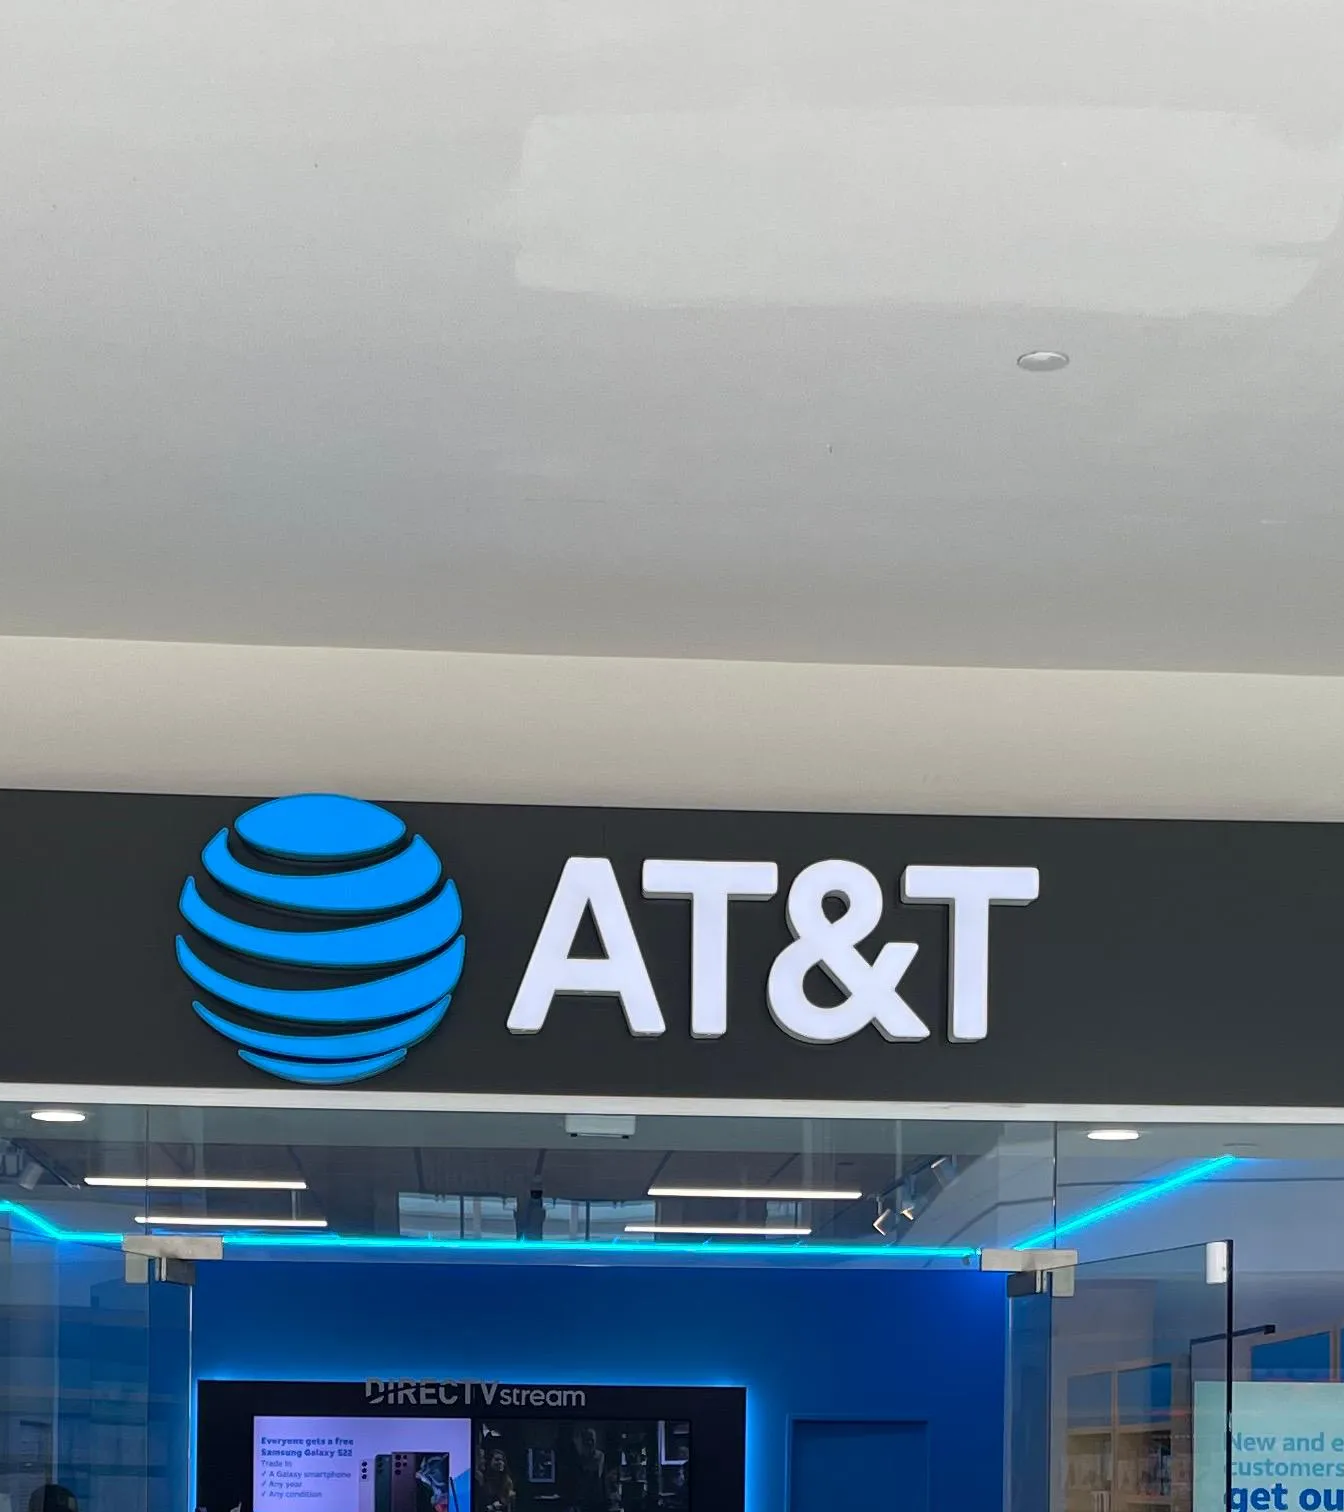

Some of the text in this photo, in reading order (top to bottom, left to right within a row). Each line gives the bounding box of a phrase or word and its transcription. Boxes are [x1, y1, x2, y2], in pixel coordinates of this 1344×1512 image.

[506, 856, 1041, 1045] AT&T
[365, 1376, 586, 1407] DIRECTV stream
[306, 1437, 325, 1446] gets
[335, 1437, 354, 1446] free
[1226, 1432, 1276, 1452] New
[1282, 1432, 1325, 1452] and
[261, 1448, 302, 1457] Samsung
[304, 1448, 335, 1458] Galaxy
[276, 1471, 302, 1479] Galaxy
[304, 1471, 351, 1480] smartphone
